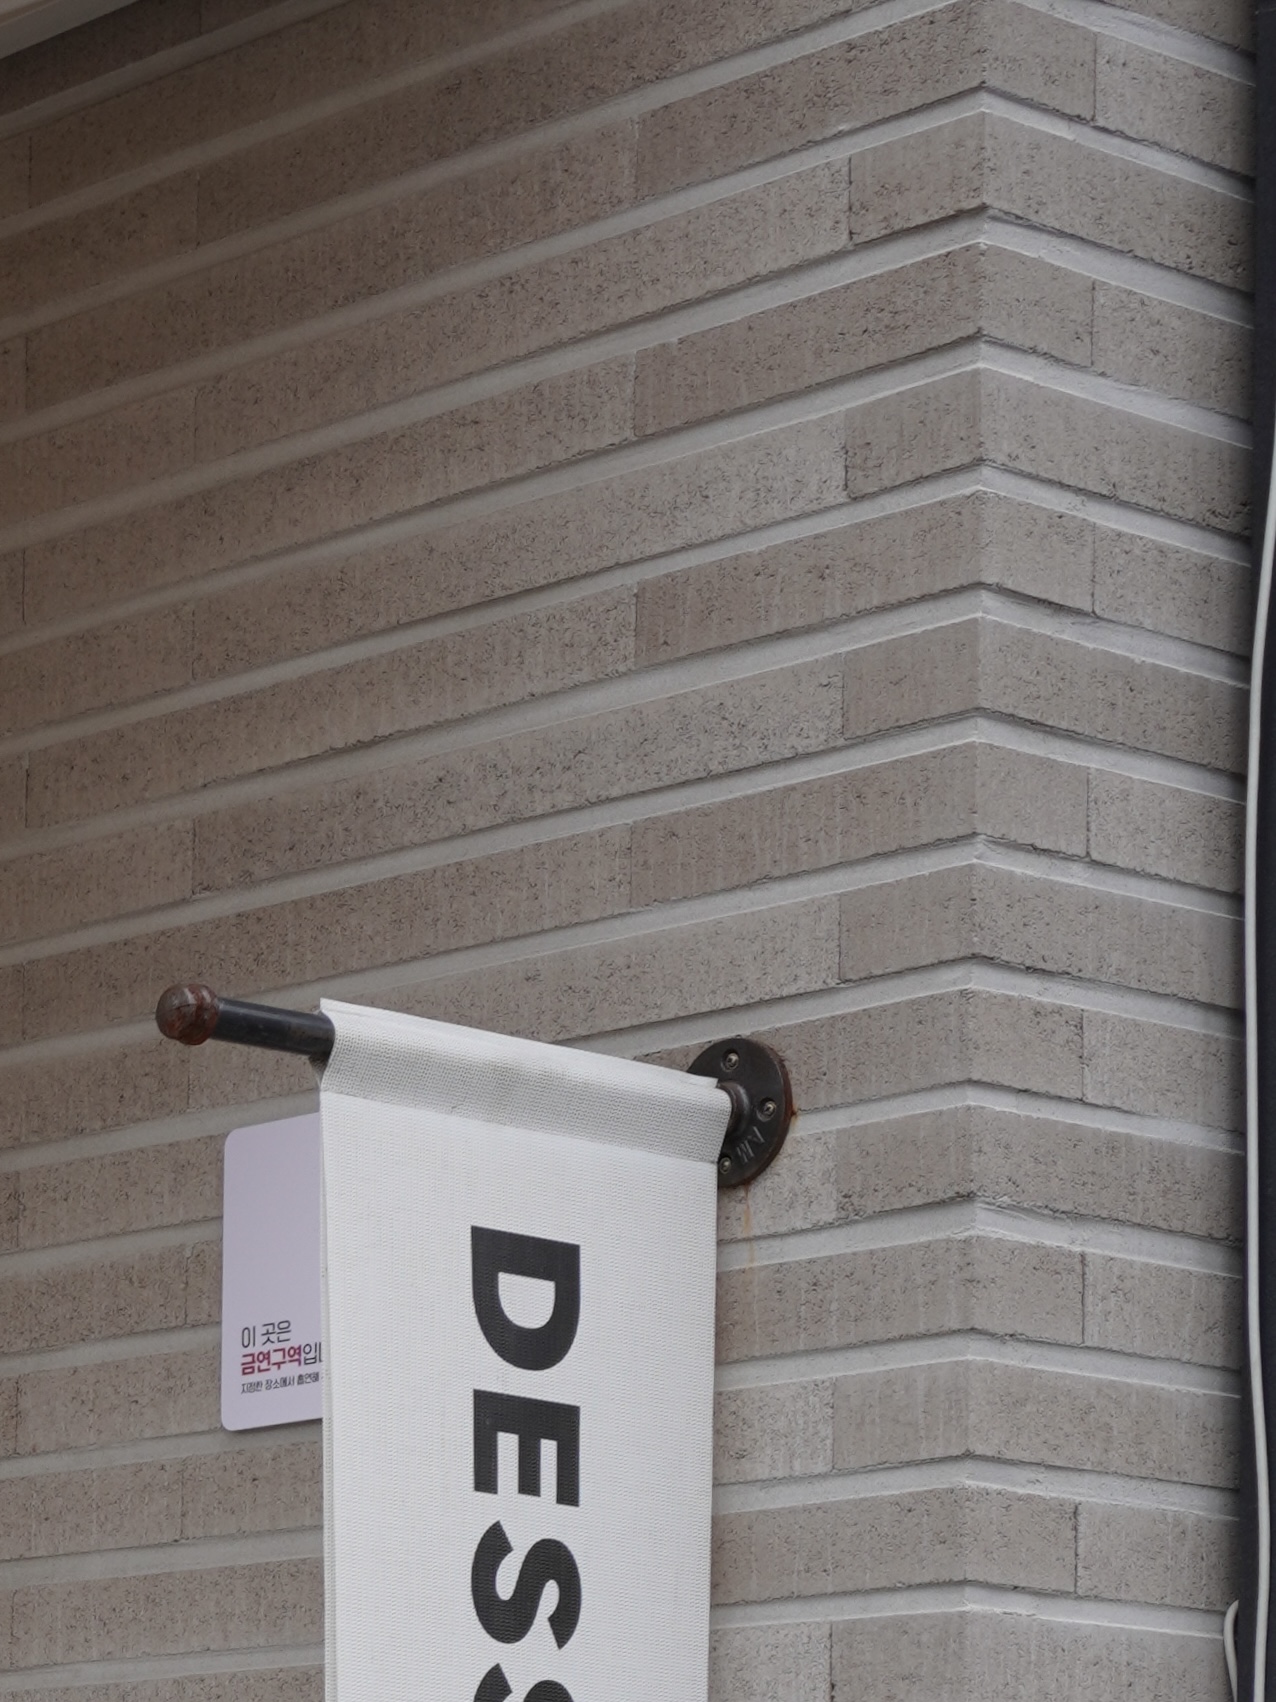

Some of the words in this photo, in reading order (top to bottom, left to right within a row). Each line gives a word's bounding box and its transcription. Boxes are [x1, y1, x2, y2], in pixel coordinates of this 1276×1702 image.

[241, 1325, 256, 1349] 이
[261, 1319, 292, 1347] 곳은
[240, 1341, 323, 1376] 금연구역입
[264, 1375, 296, 1391] 장소에서
